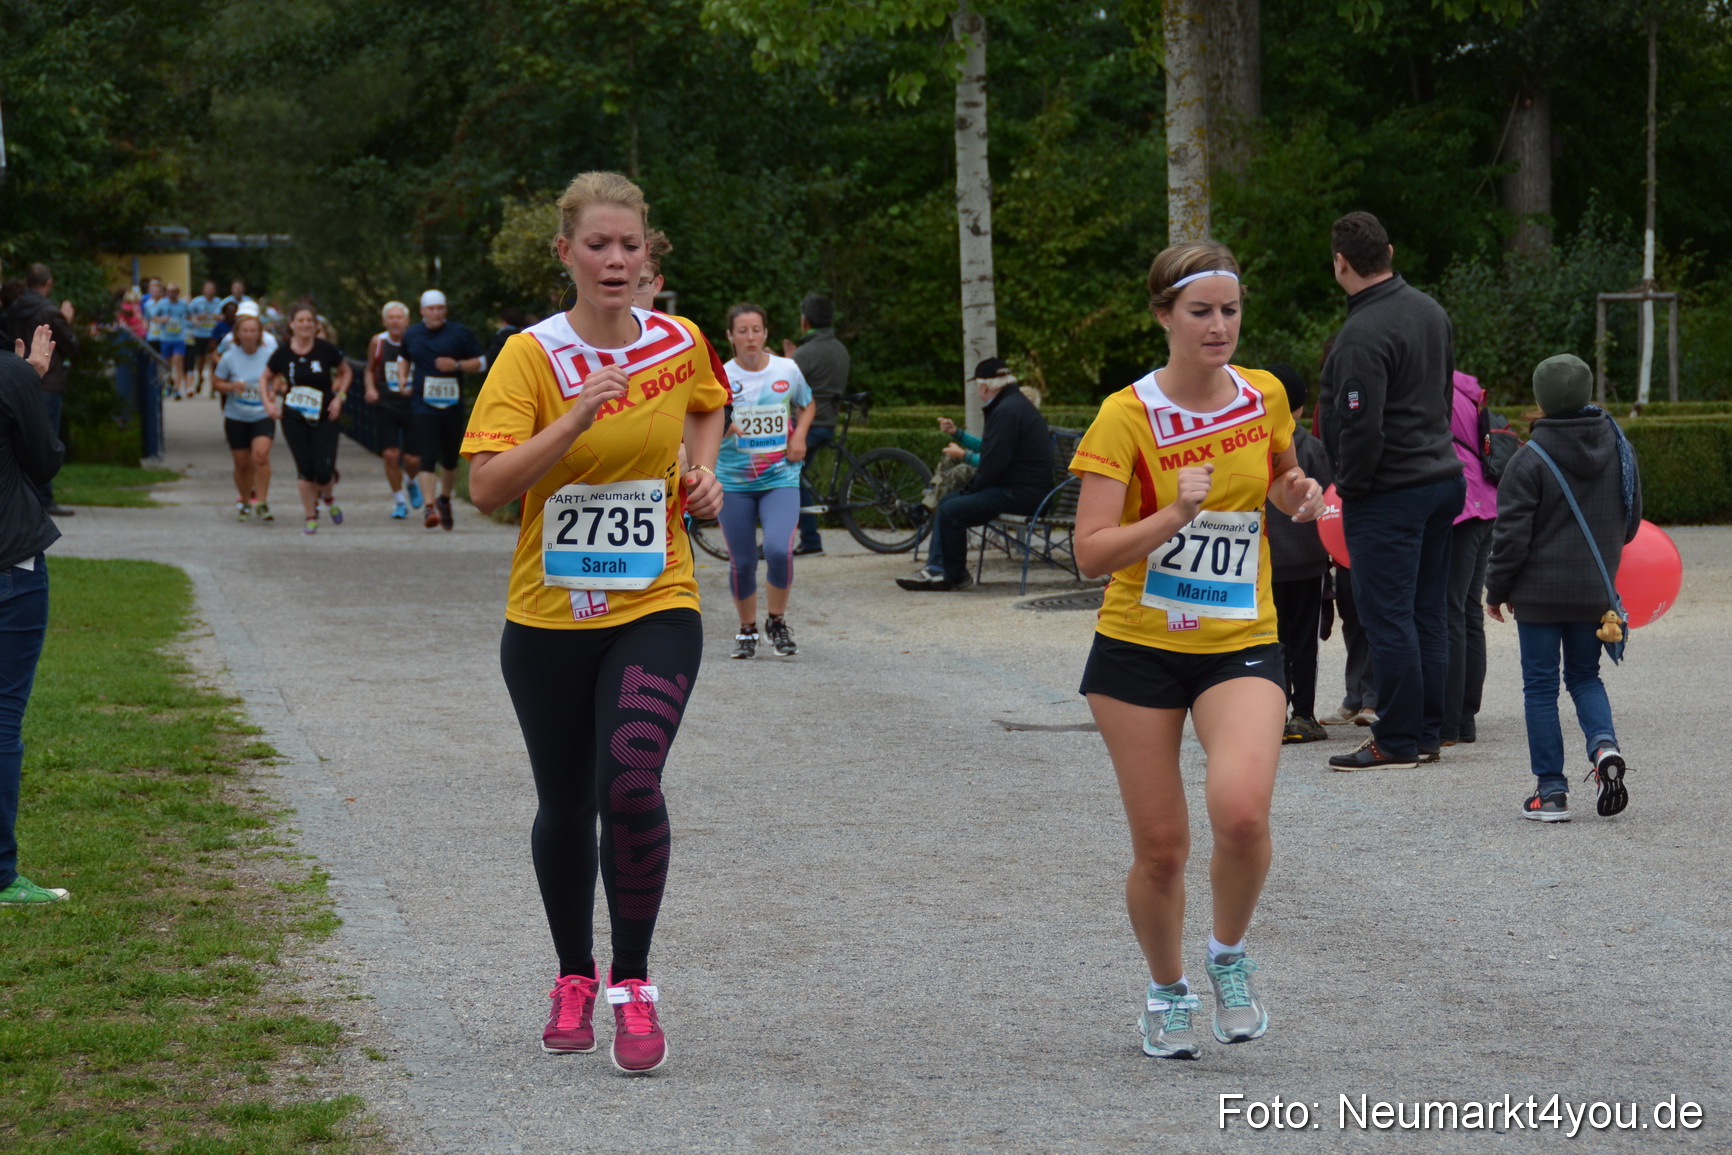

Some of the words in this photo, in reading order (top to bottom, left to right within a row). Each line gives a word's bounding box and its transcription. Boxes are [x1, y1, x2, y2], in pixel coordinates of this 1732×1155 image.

[594, 384, 636, 421] AX
[640, 359, 696, 400] BÖGL
[741, 415, 784, 435] 2339
[750, 439, 776, 447] Daniela
[1159, 443, 1216, 471] MAX
[1220, 425, 1268, 454] BÖGL
[549, 494, 587, 504] PARTL
[590, 492, 646, 501] Neumarkt
[556, 507, 655, 547] 2735
[1200, 520, 1246, 532] Neumarkt
[547, 542, 553, 550] D
[1160, 531, 1251, 577] 2707
[582, 557, 627, 573] Sarah
[1151, 562, 1157, 570] D
[1177, 582, 1228, 603] Marina
[609, 720, 670, 814] DO
